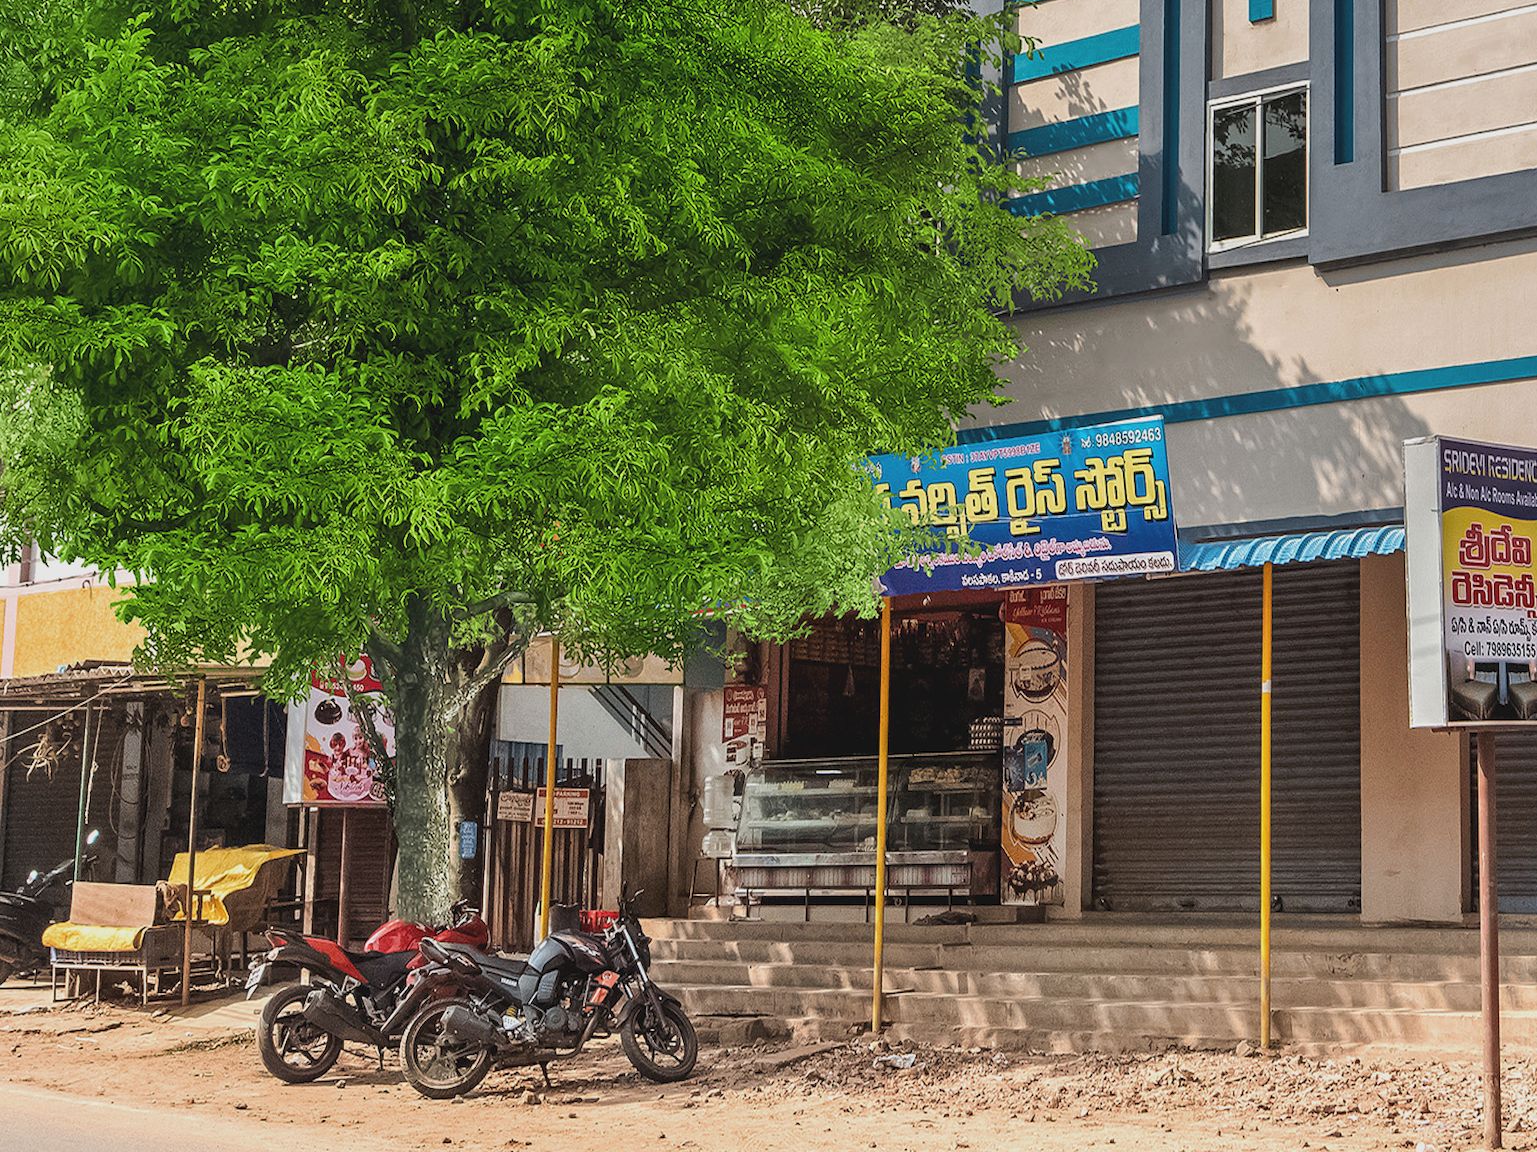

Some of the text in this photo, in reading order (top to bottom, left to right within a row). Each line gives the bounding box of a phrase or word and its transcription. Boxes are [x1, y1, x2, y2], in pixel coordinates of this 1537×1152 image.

[1095, 426, 1162, 447] 9848592463
[1443, 449, 1486, 477] SRIDEVI
[1004, 458, 1067, 536] రైస్
[1073, 447, 1169, 533] స్టోర్స్
[1465, 484, 1480, 501] Non
[1492, 487, 1515, 505] Rooms
[1458, 522, 1532, 569] శ్రీదేవి
[1464, 640, 1537, 658] Cell: 7989635155
